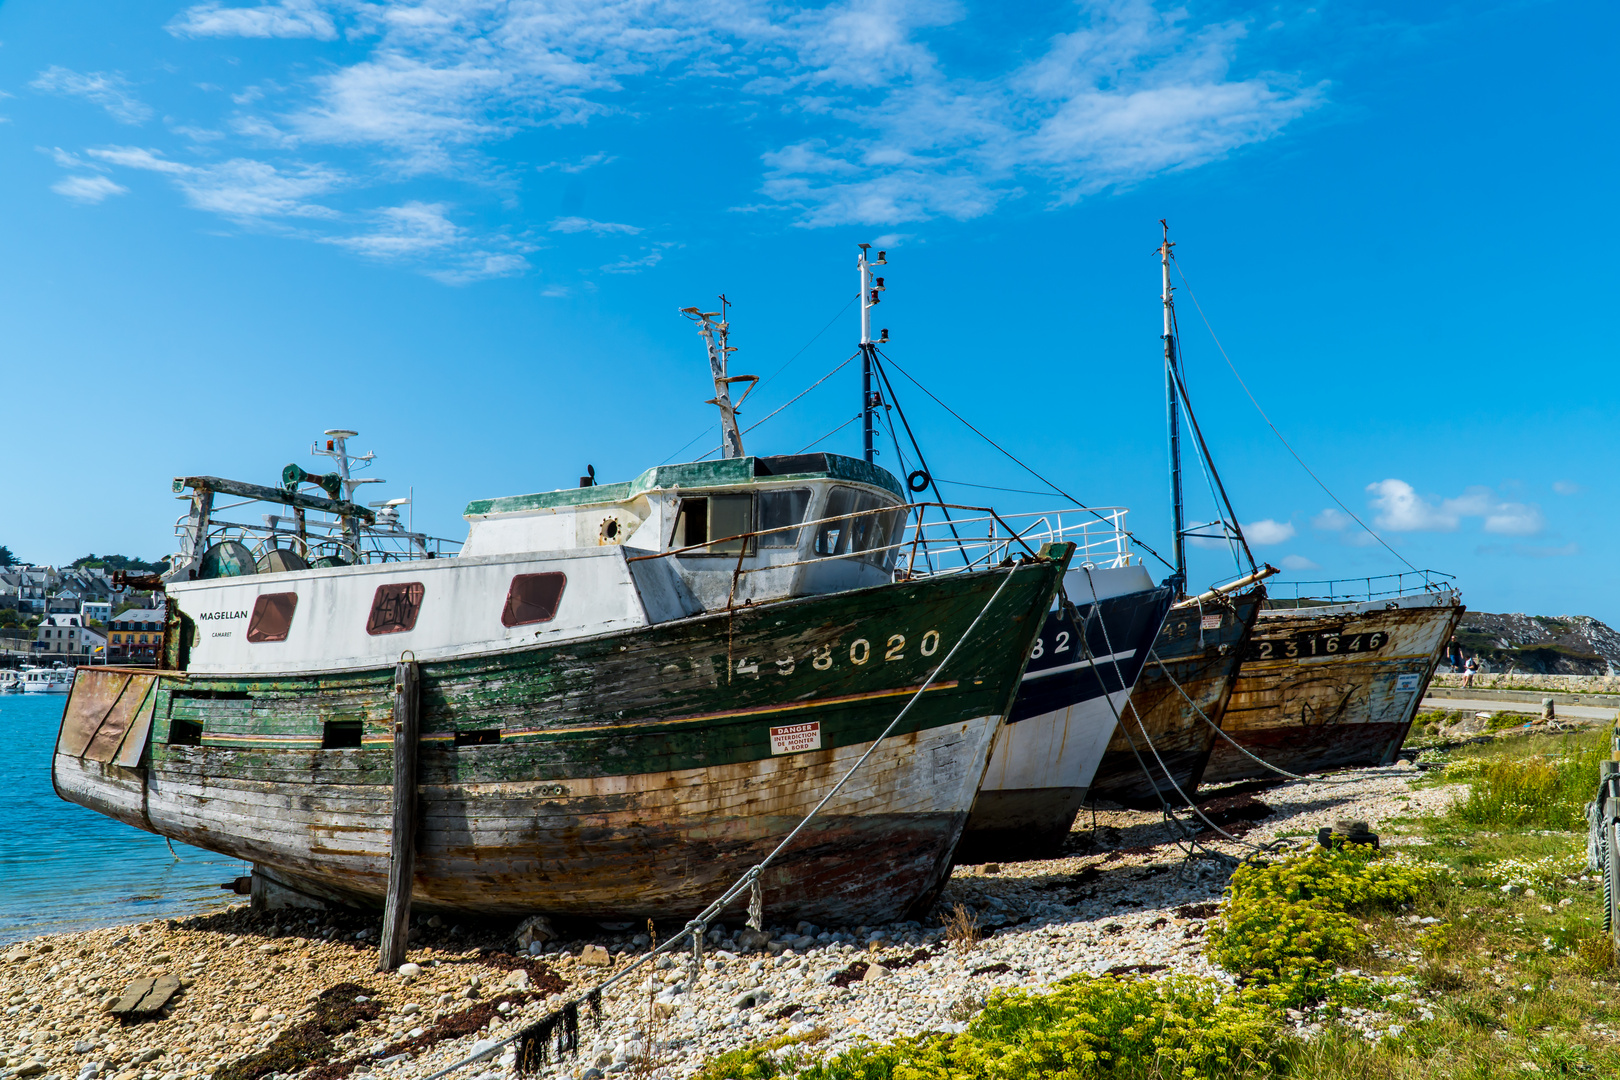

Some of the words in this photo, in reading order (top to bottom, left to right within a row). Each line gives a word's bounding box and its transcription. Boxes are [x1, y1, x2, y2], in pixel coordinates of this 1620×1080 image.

[199, 610, 248, 621] MAGELLAN
[1259, 632, 1382, 660] 231646
[778, 725, 812, 734] DANGER
[774, 732, 816, 741] INTERDICTION
[788, 737, 814, 746] MONTER
[791, 743, 809, 751] BORD
